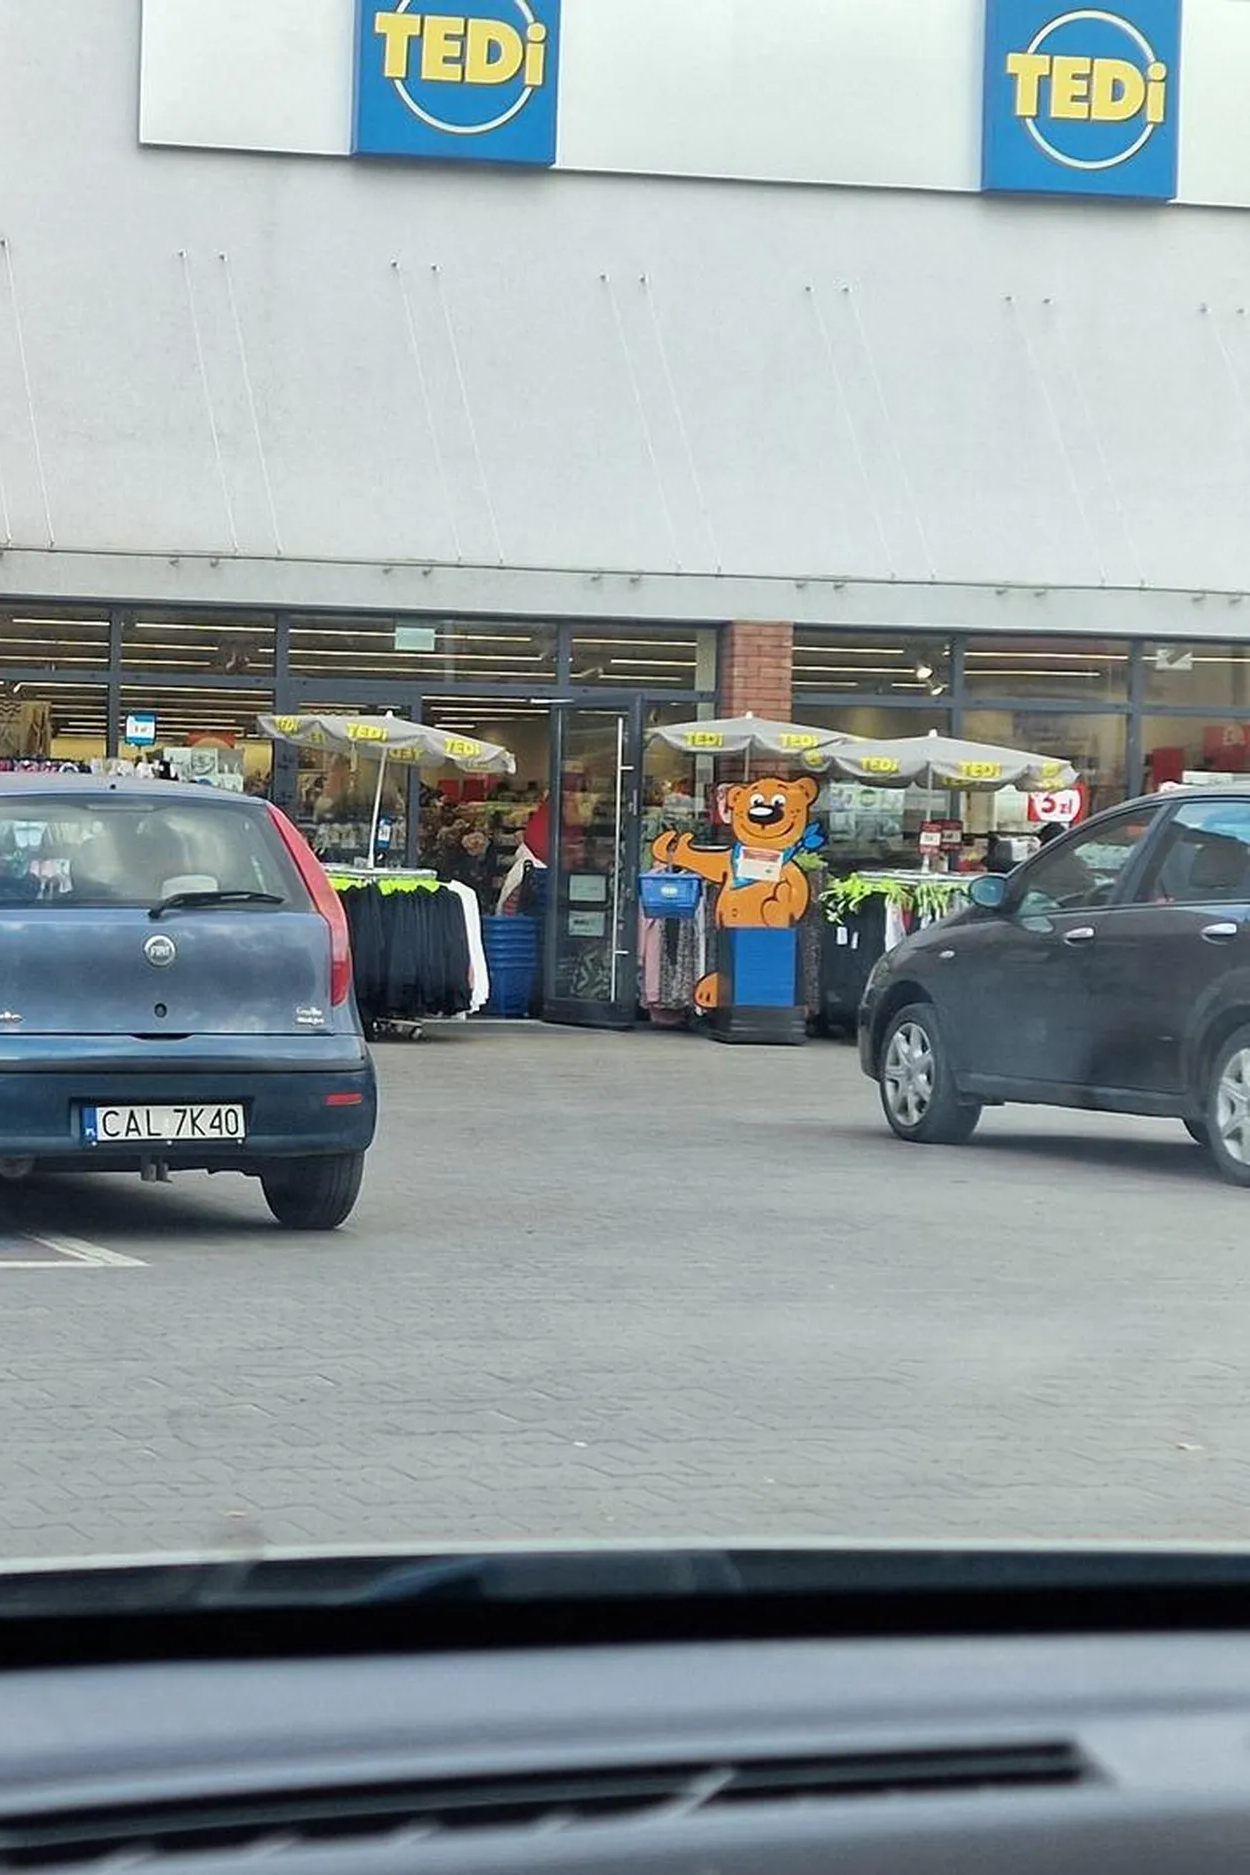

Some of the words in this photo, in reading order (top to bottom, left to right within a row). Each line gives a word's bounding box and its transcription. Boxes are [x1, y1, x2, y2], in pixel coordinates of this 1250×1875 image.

[374, 11, 546, 86] TEDi
[1006, 53, 1167, 123] TEDi
[346, 722, 389, 742] TEDi
[101, 1109, 162, 1137] CAL
[173, 1107, 239, 1136] 7K40
